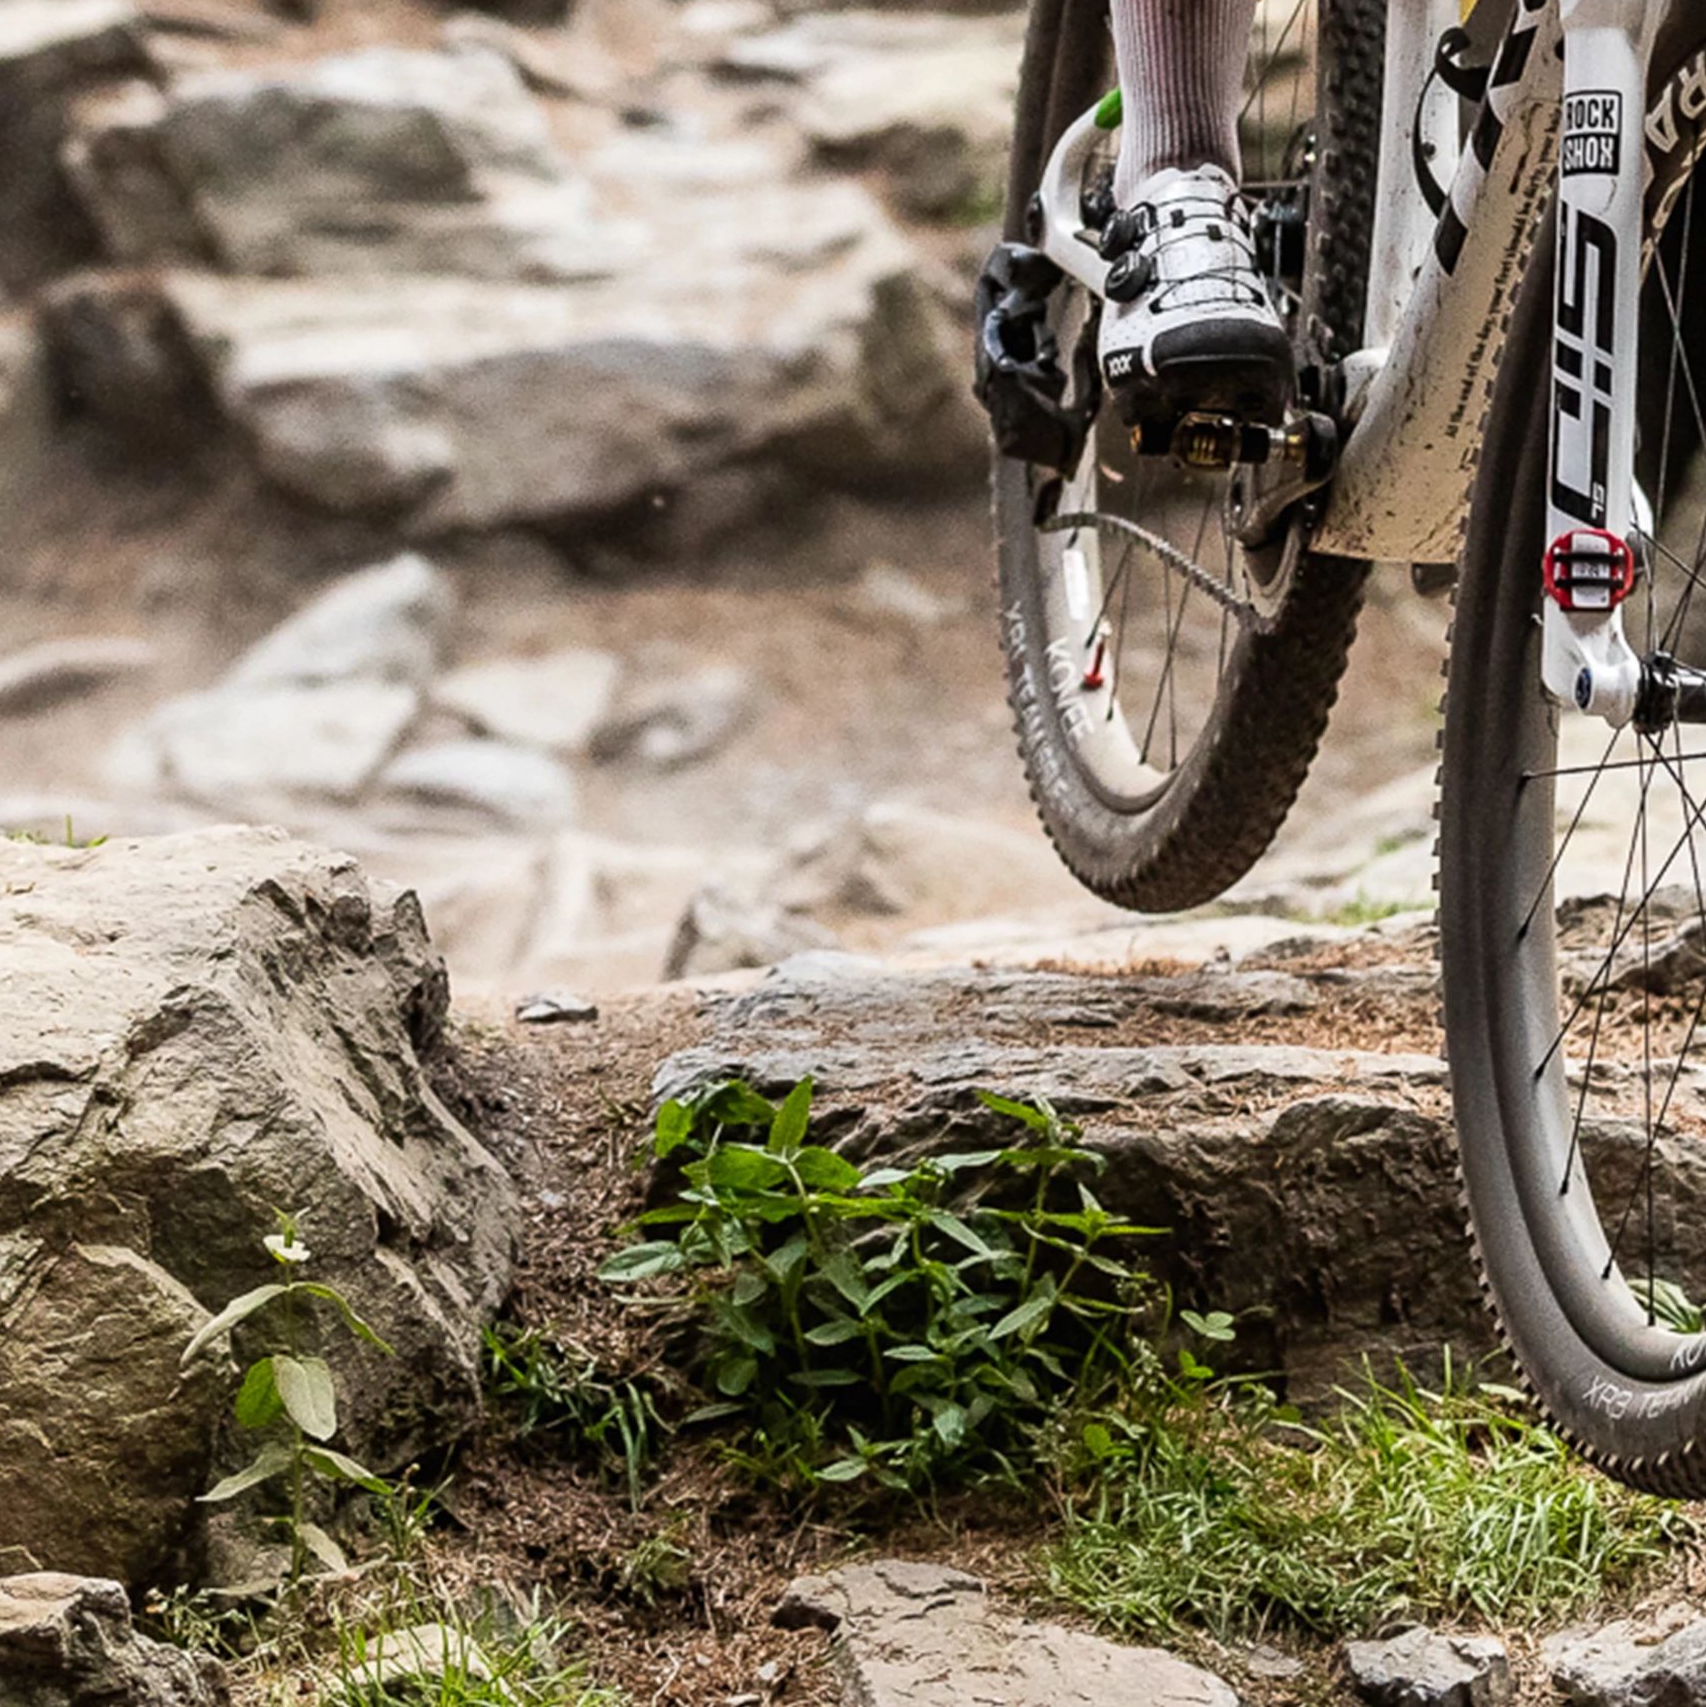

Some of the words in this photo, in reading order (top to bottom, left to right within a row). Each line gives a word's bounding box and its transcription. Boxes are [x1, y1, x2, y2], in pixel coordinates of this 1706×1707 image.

[1566, 97, 1616, 133] ROCK
[1562, 135, 1616, 173] SHOX
[1591, 481, 1605, 520] SL
[1044, 636, 1094, 748] KOVEE
